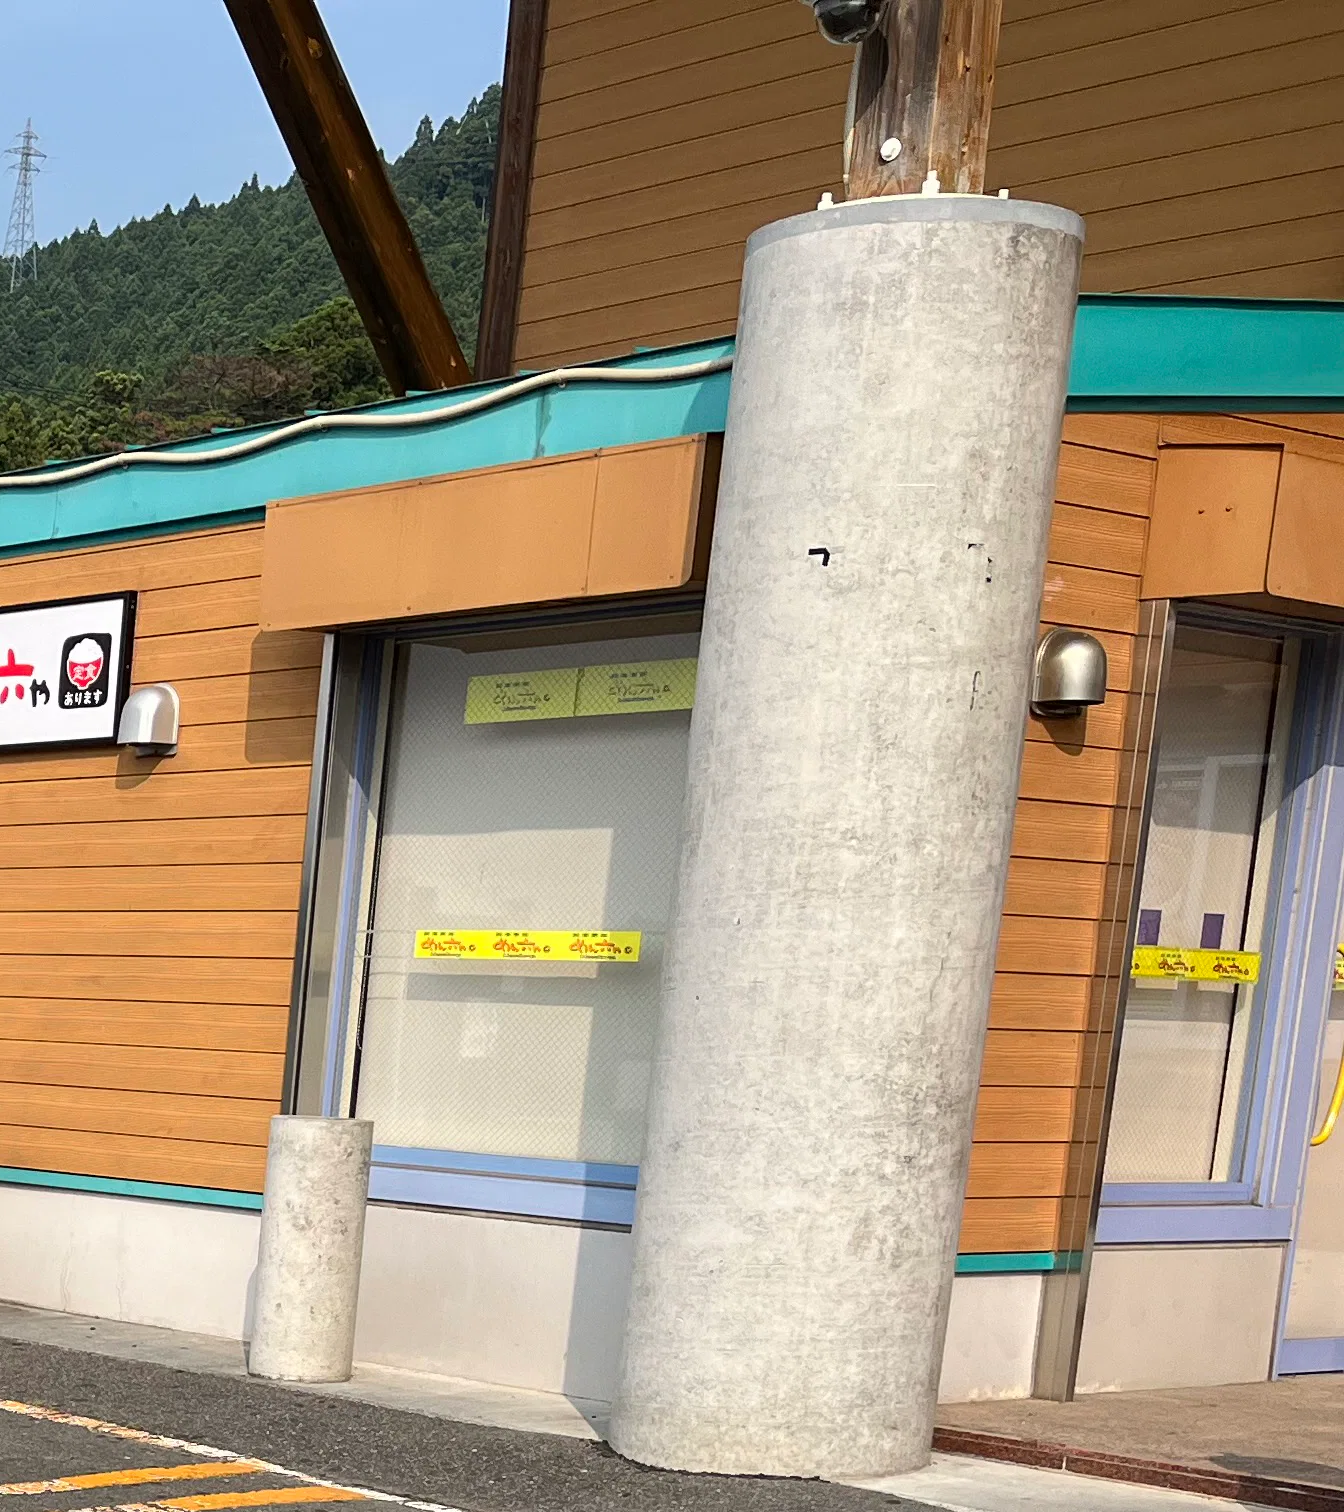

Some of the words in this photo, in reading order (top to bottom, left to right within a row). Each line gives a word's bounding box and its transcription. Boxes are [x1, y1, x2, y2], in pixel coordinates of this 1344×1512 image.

[73, 664, 97, 681] 定食
[64, 689, 102, 706] あります
